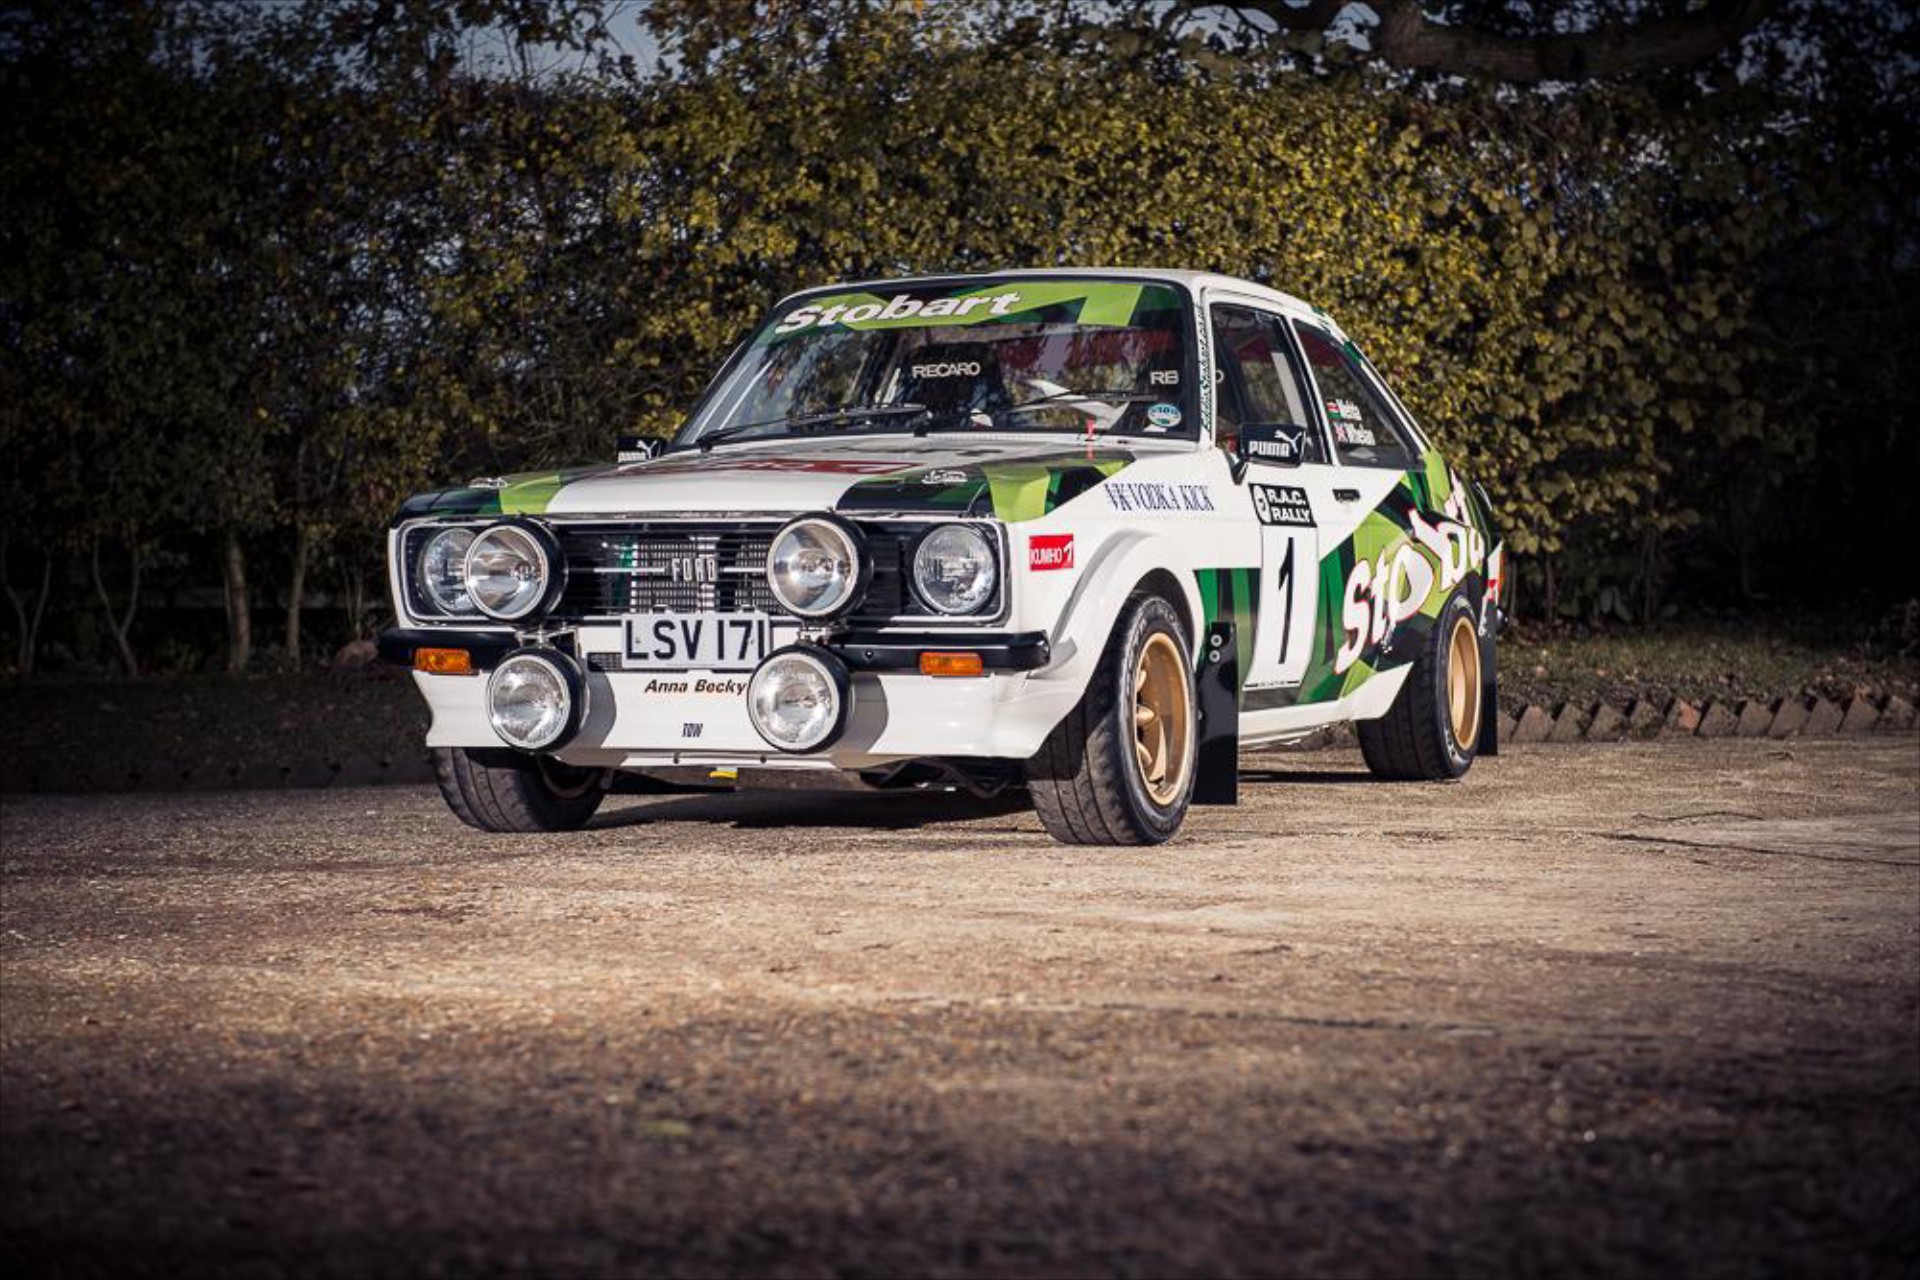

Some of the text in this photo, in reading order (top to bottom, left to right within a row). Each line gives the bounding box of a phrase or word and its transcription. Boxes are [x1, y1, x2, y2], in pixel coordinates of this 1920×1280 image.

[775, 289, 1023, 334] Stobart
[911, 361, 980, 378] RECARO
[1248, 440, 1291, 457] PUMA
[1103, 483, 1215, 512] VK VODKA KICK
[1265, 488, 1307, 505] R.A.C.
[1270, 506, 1311, 523] RALLY
[672, 557, 719, 583] FORD
[1278, 535, 1295, 665] 1
[625, 619, 765, 660] LSV 171
[644, 678, 747, 696] Anna Becky
[681, 722, 704, 738] TOW
